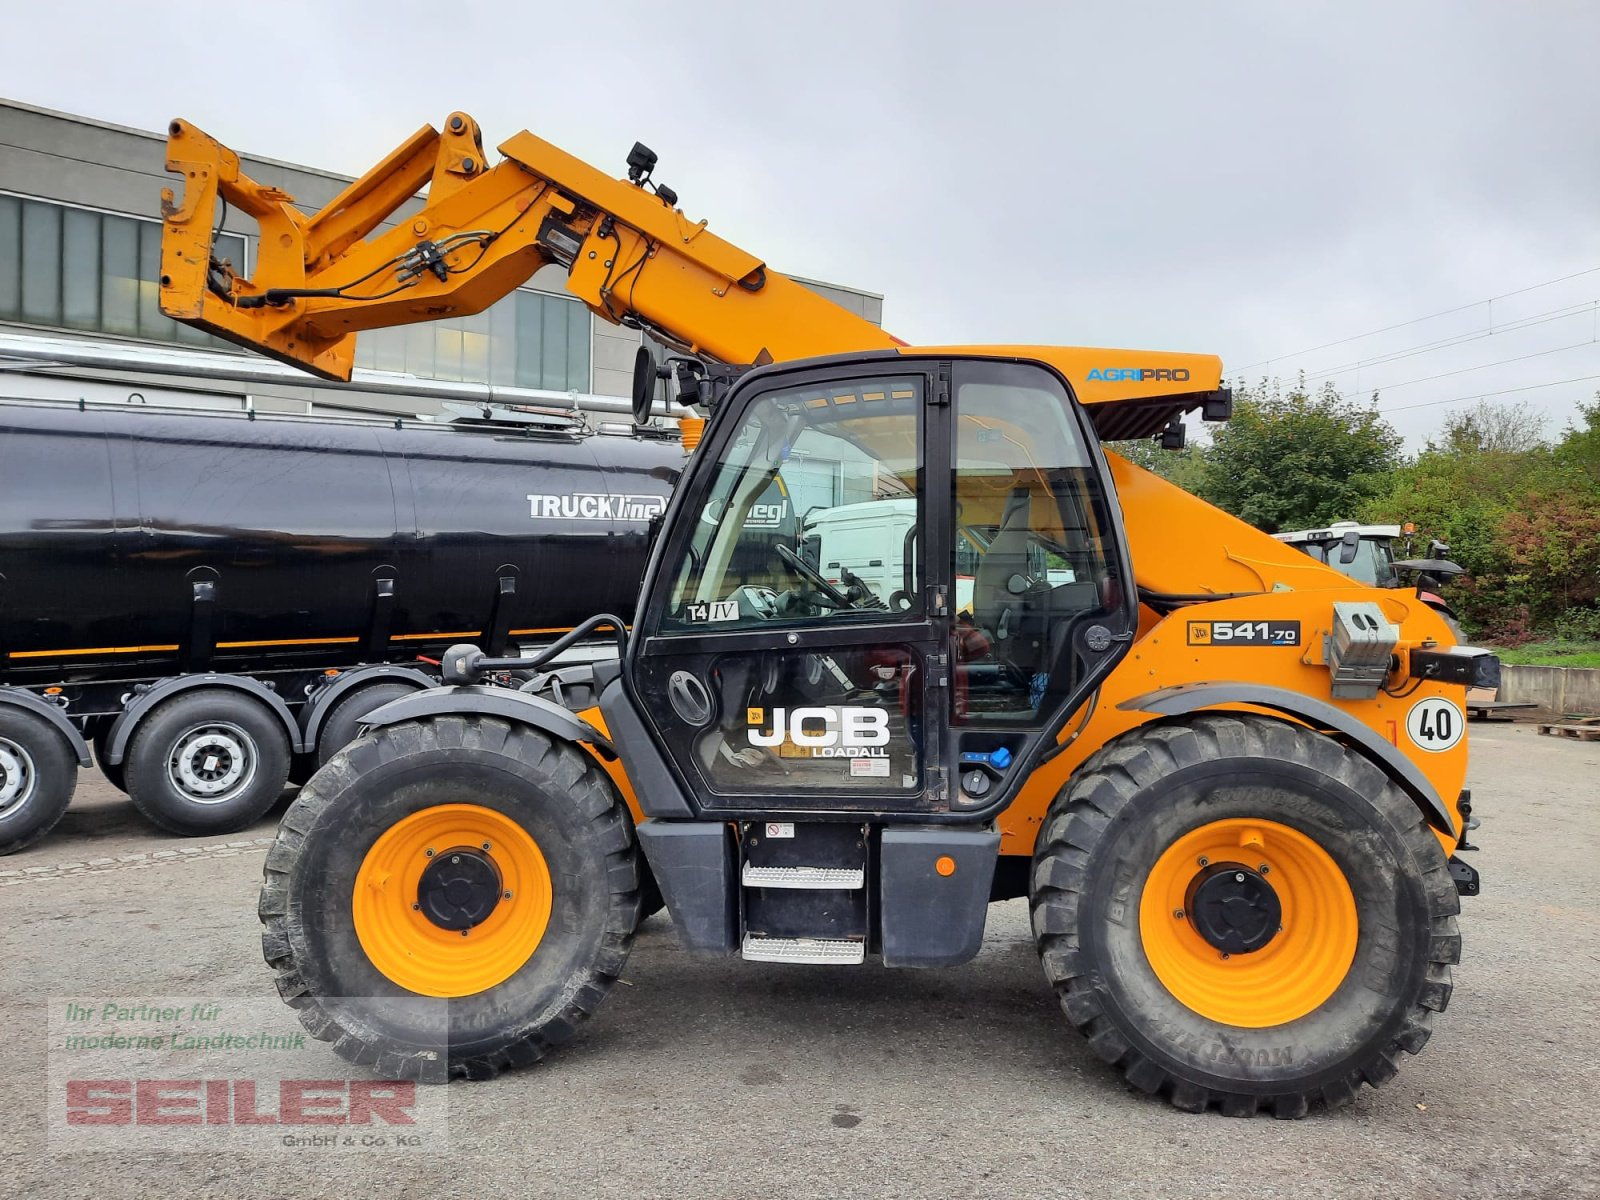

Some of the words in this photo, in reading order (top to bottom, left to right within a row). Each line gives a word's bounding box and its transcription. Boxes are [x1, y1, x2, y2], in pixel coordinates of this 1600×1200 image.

[1086, 368, 1190, 381] AGRIPRO
[1213, 622, 1296, 640] 541-70
[747, 707, 891, 747] JCB
[1420, 708, 1452, 741] 40
[812, 747, 890, 758] LOADALL
